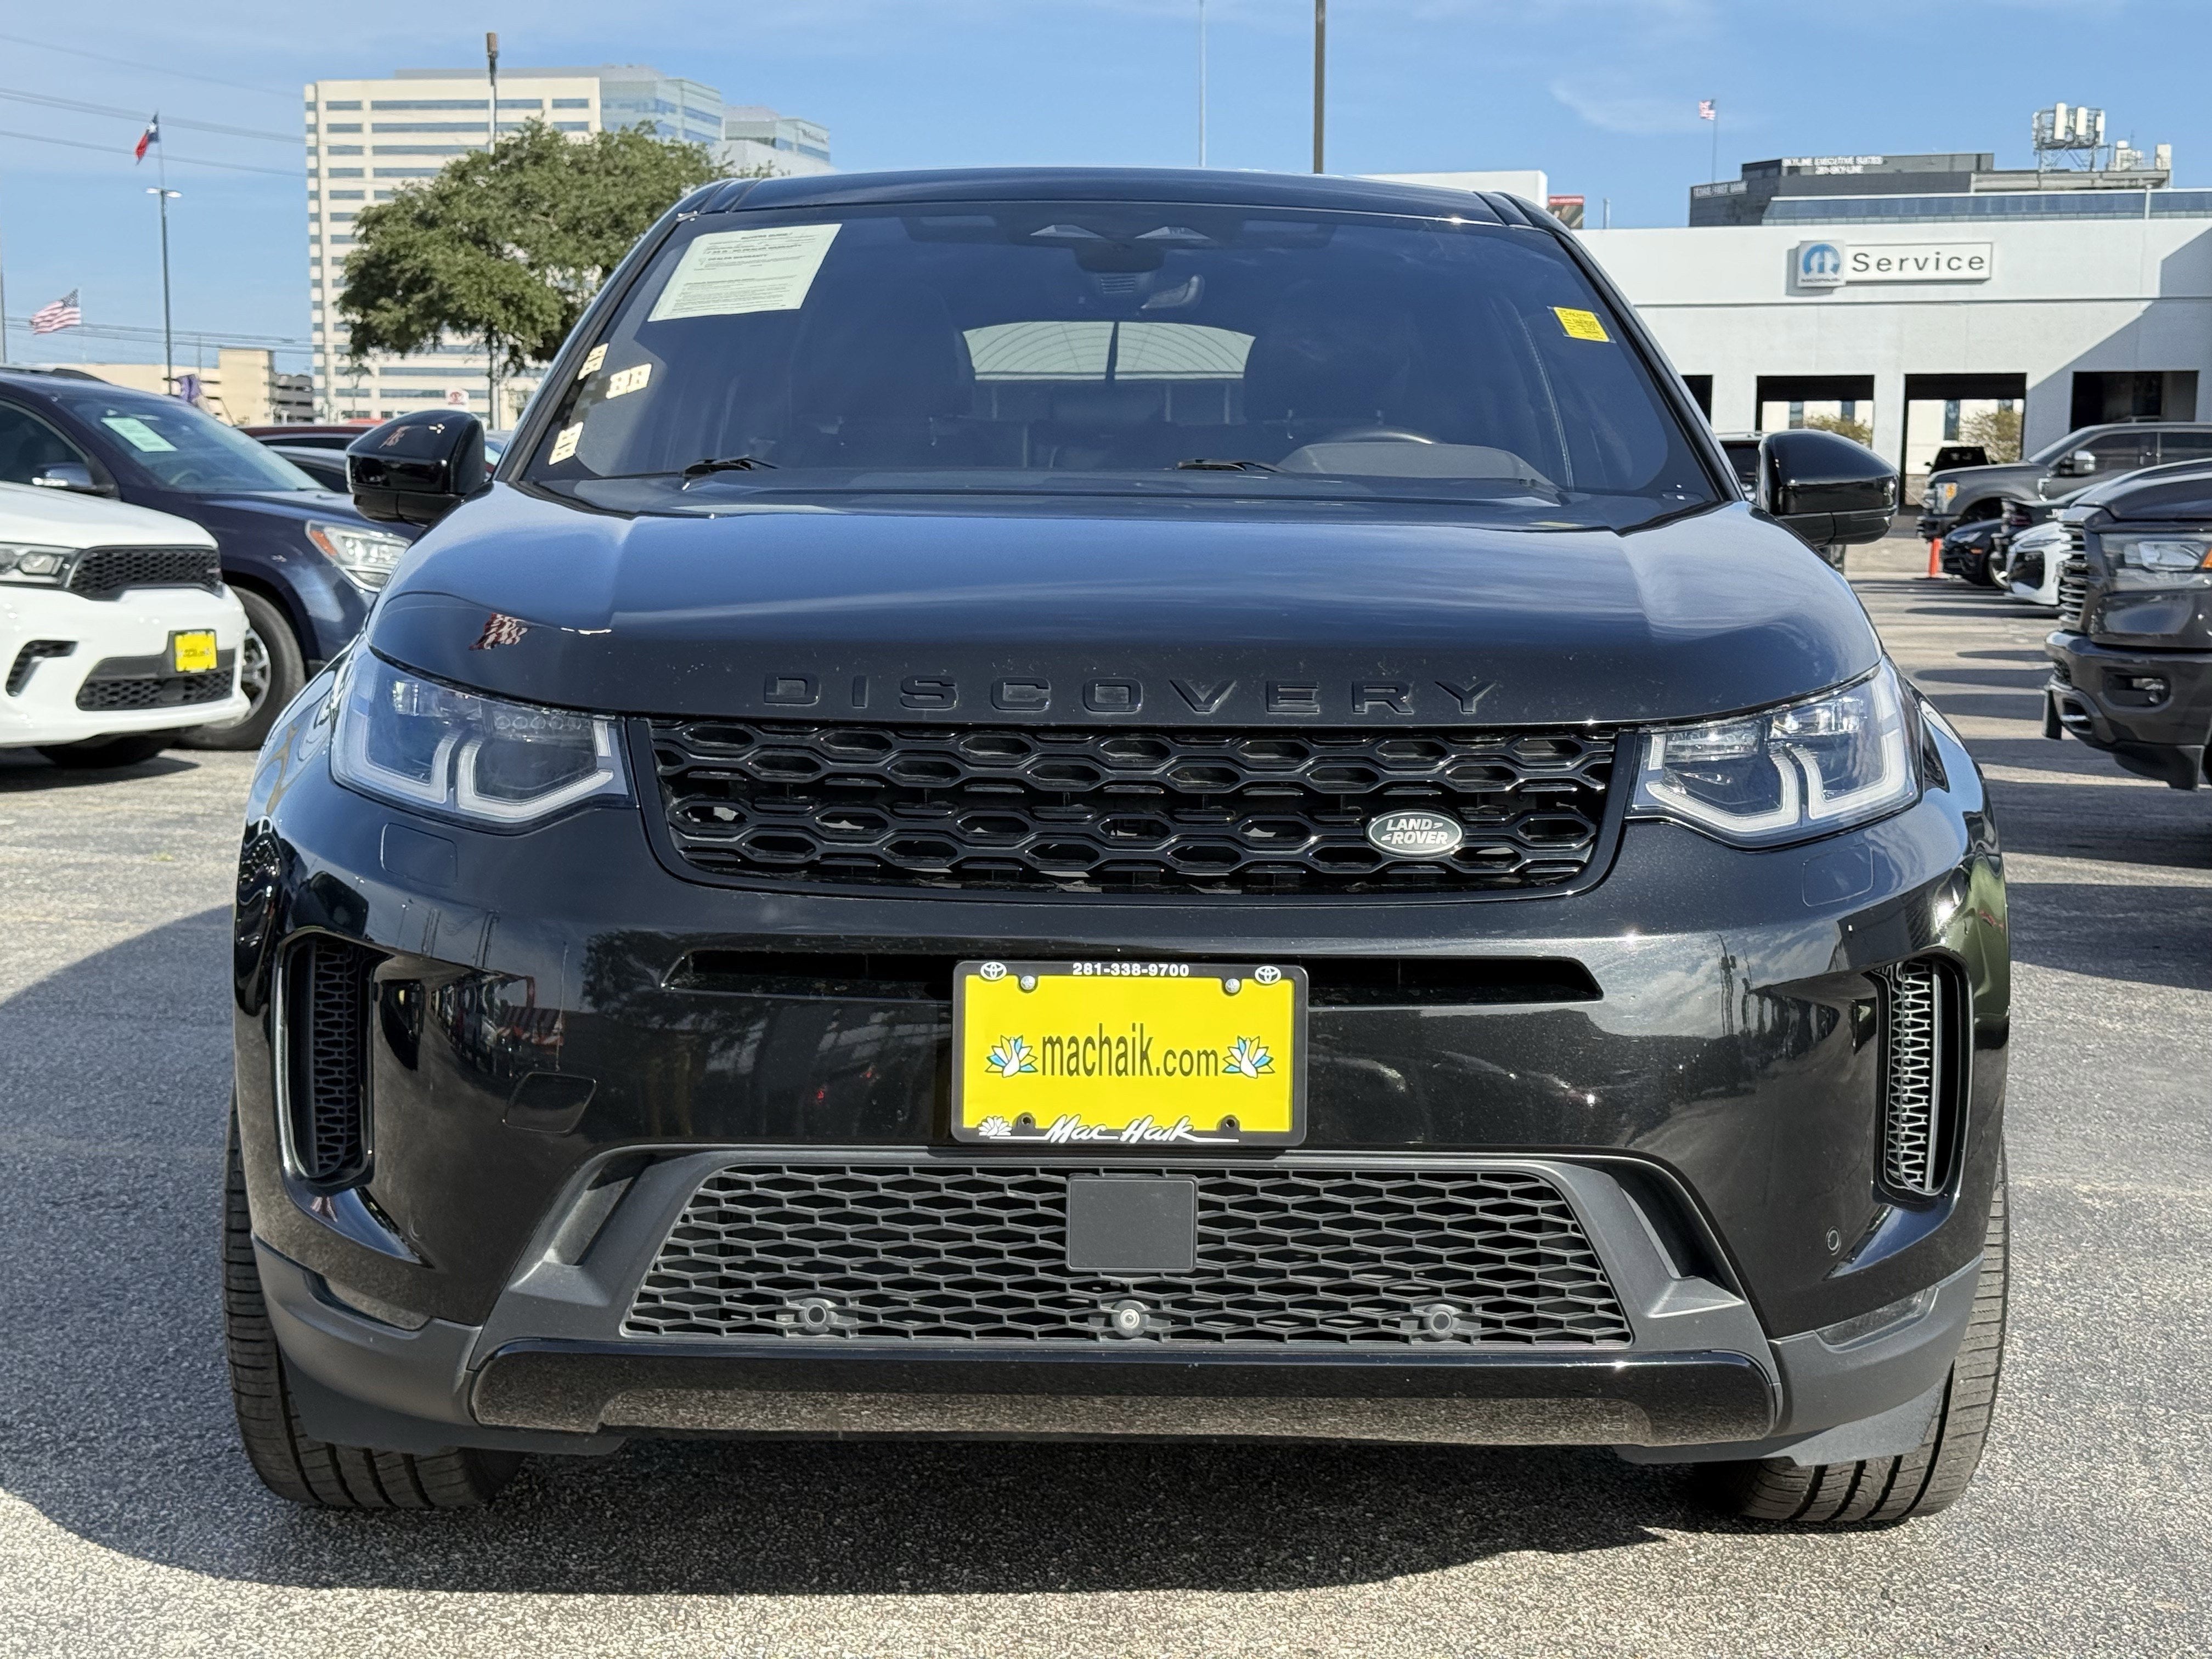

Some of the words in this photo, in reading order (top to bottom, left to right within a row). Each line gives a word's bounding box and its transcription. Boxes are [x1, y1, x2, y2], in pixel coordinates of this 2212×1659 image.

[1852, 251, 1985, 272] Service
[764, 675, 1497, 714] DISCOVERY
[1386, 818, 1433, 831] LAND
[1391, 831, 1448, 845] ROVER
[1072, 962, 1190, 977] 281-338-9700
[1042, 1022, 1218, 1077] machaik.com
[1043, 1113, 1119, 1144] Mac
[1119, 1114, 1197, 1144] Haik
